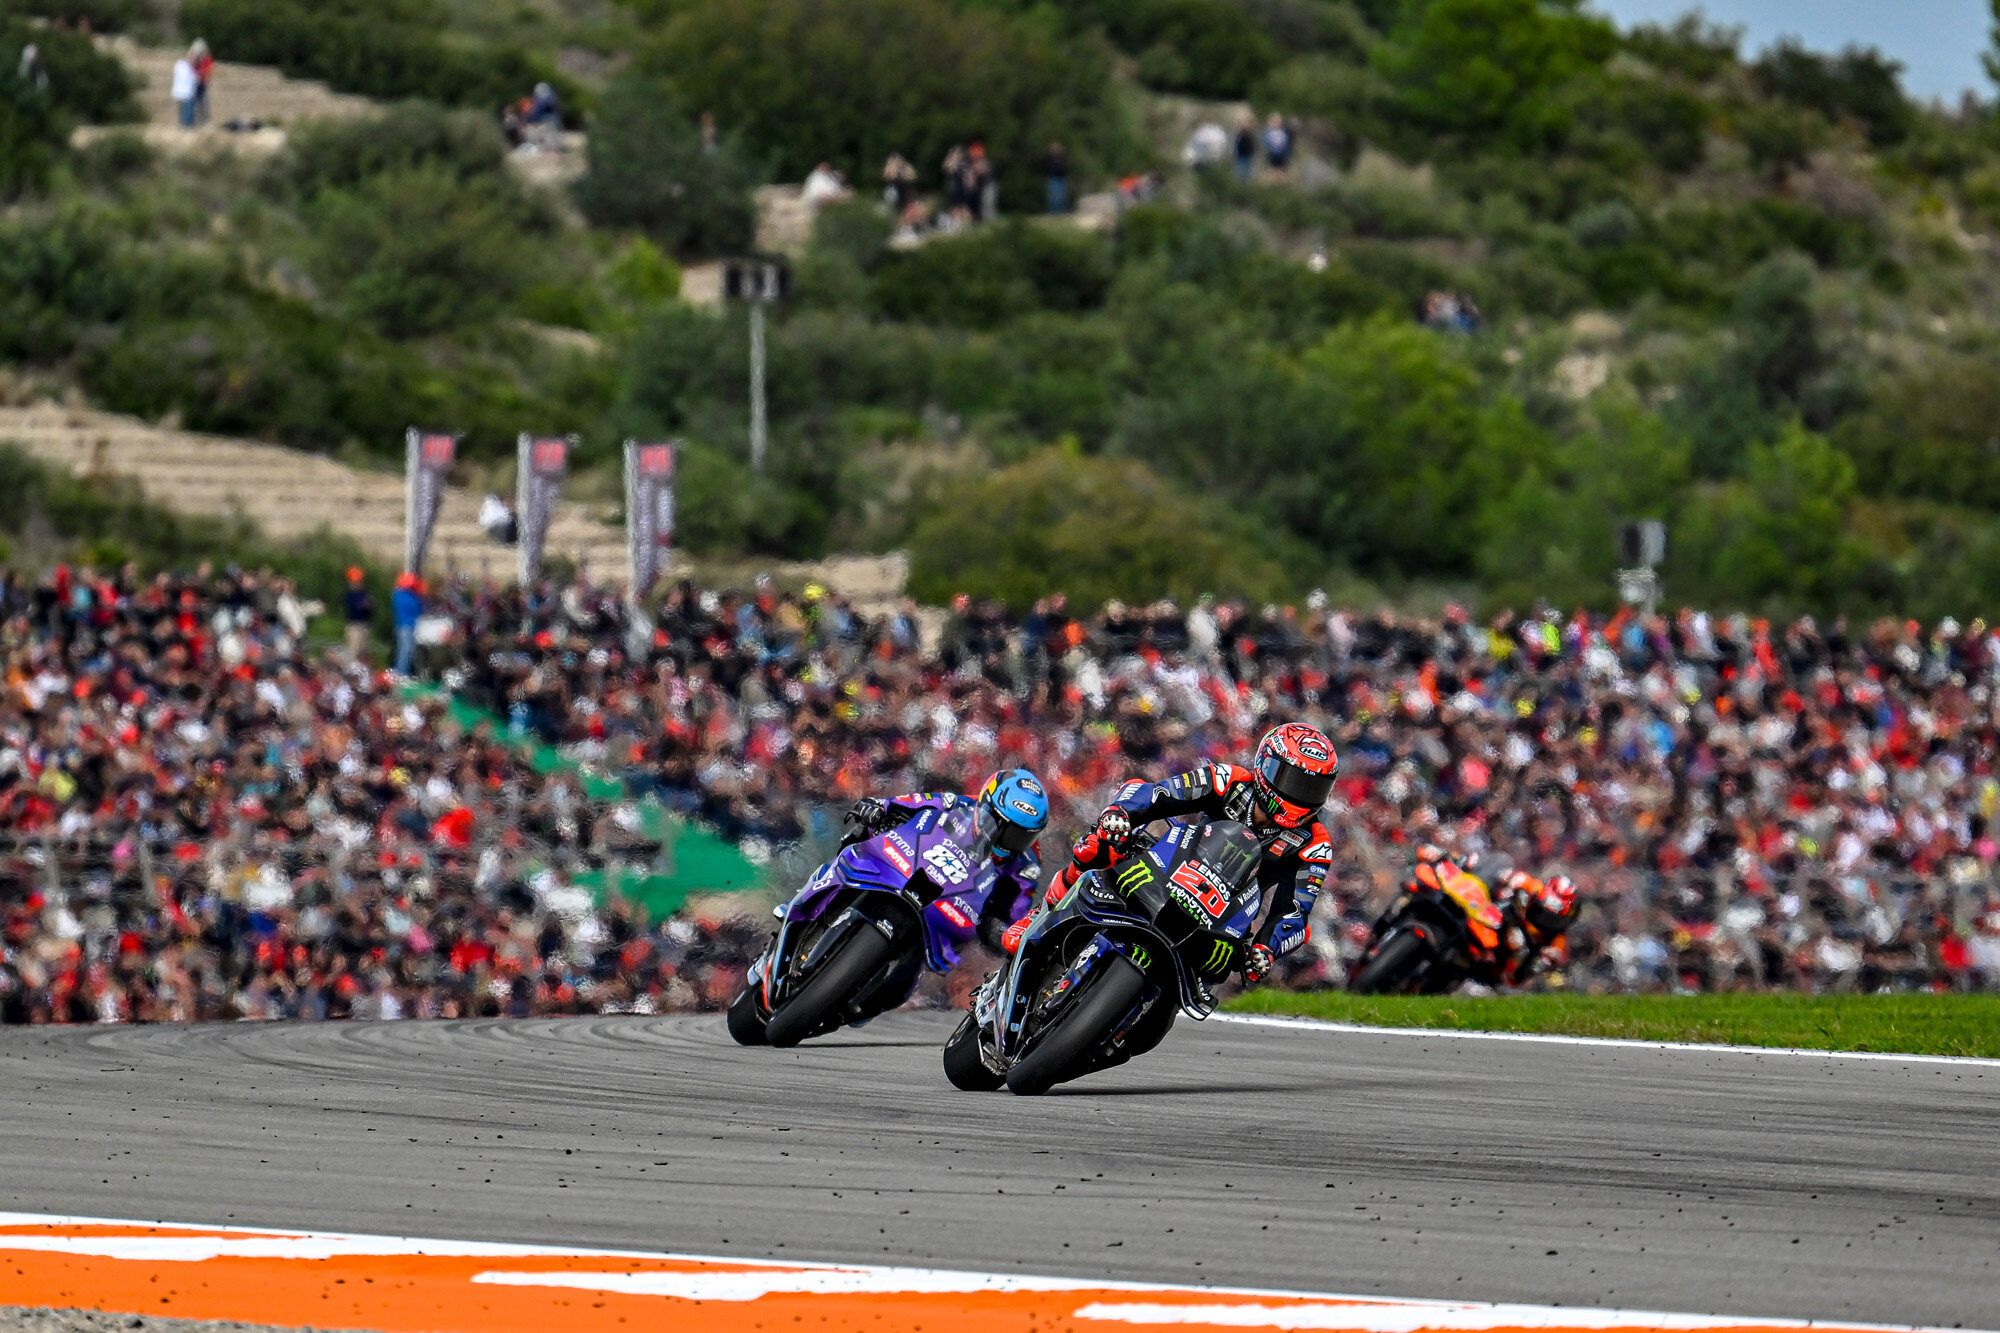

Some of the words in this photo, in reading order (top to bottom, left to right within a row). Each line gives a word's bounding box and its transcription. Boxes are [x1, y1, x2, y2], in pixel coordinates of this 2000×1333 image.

[1301, 747, 1326, 760] HJC
[1014, 801, 1038, 816] HJC
[885, 830, 915, 857] prima
[942, 838, 971, 867] prima
[884, 846, 910, 872] MOTUL
[1169, 860, 1231, 919] 20
[1198, 864, 1231, 901] ENEOS
[1165, 881, 1213, 931] MONSTER
[1170, 892, 1204, 925] ENERGY
[1281, 928, 1306, 954] YAMAHA
